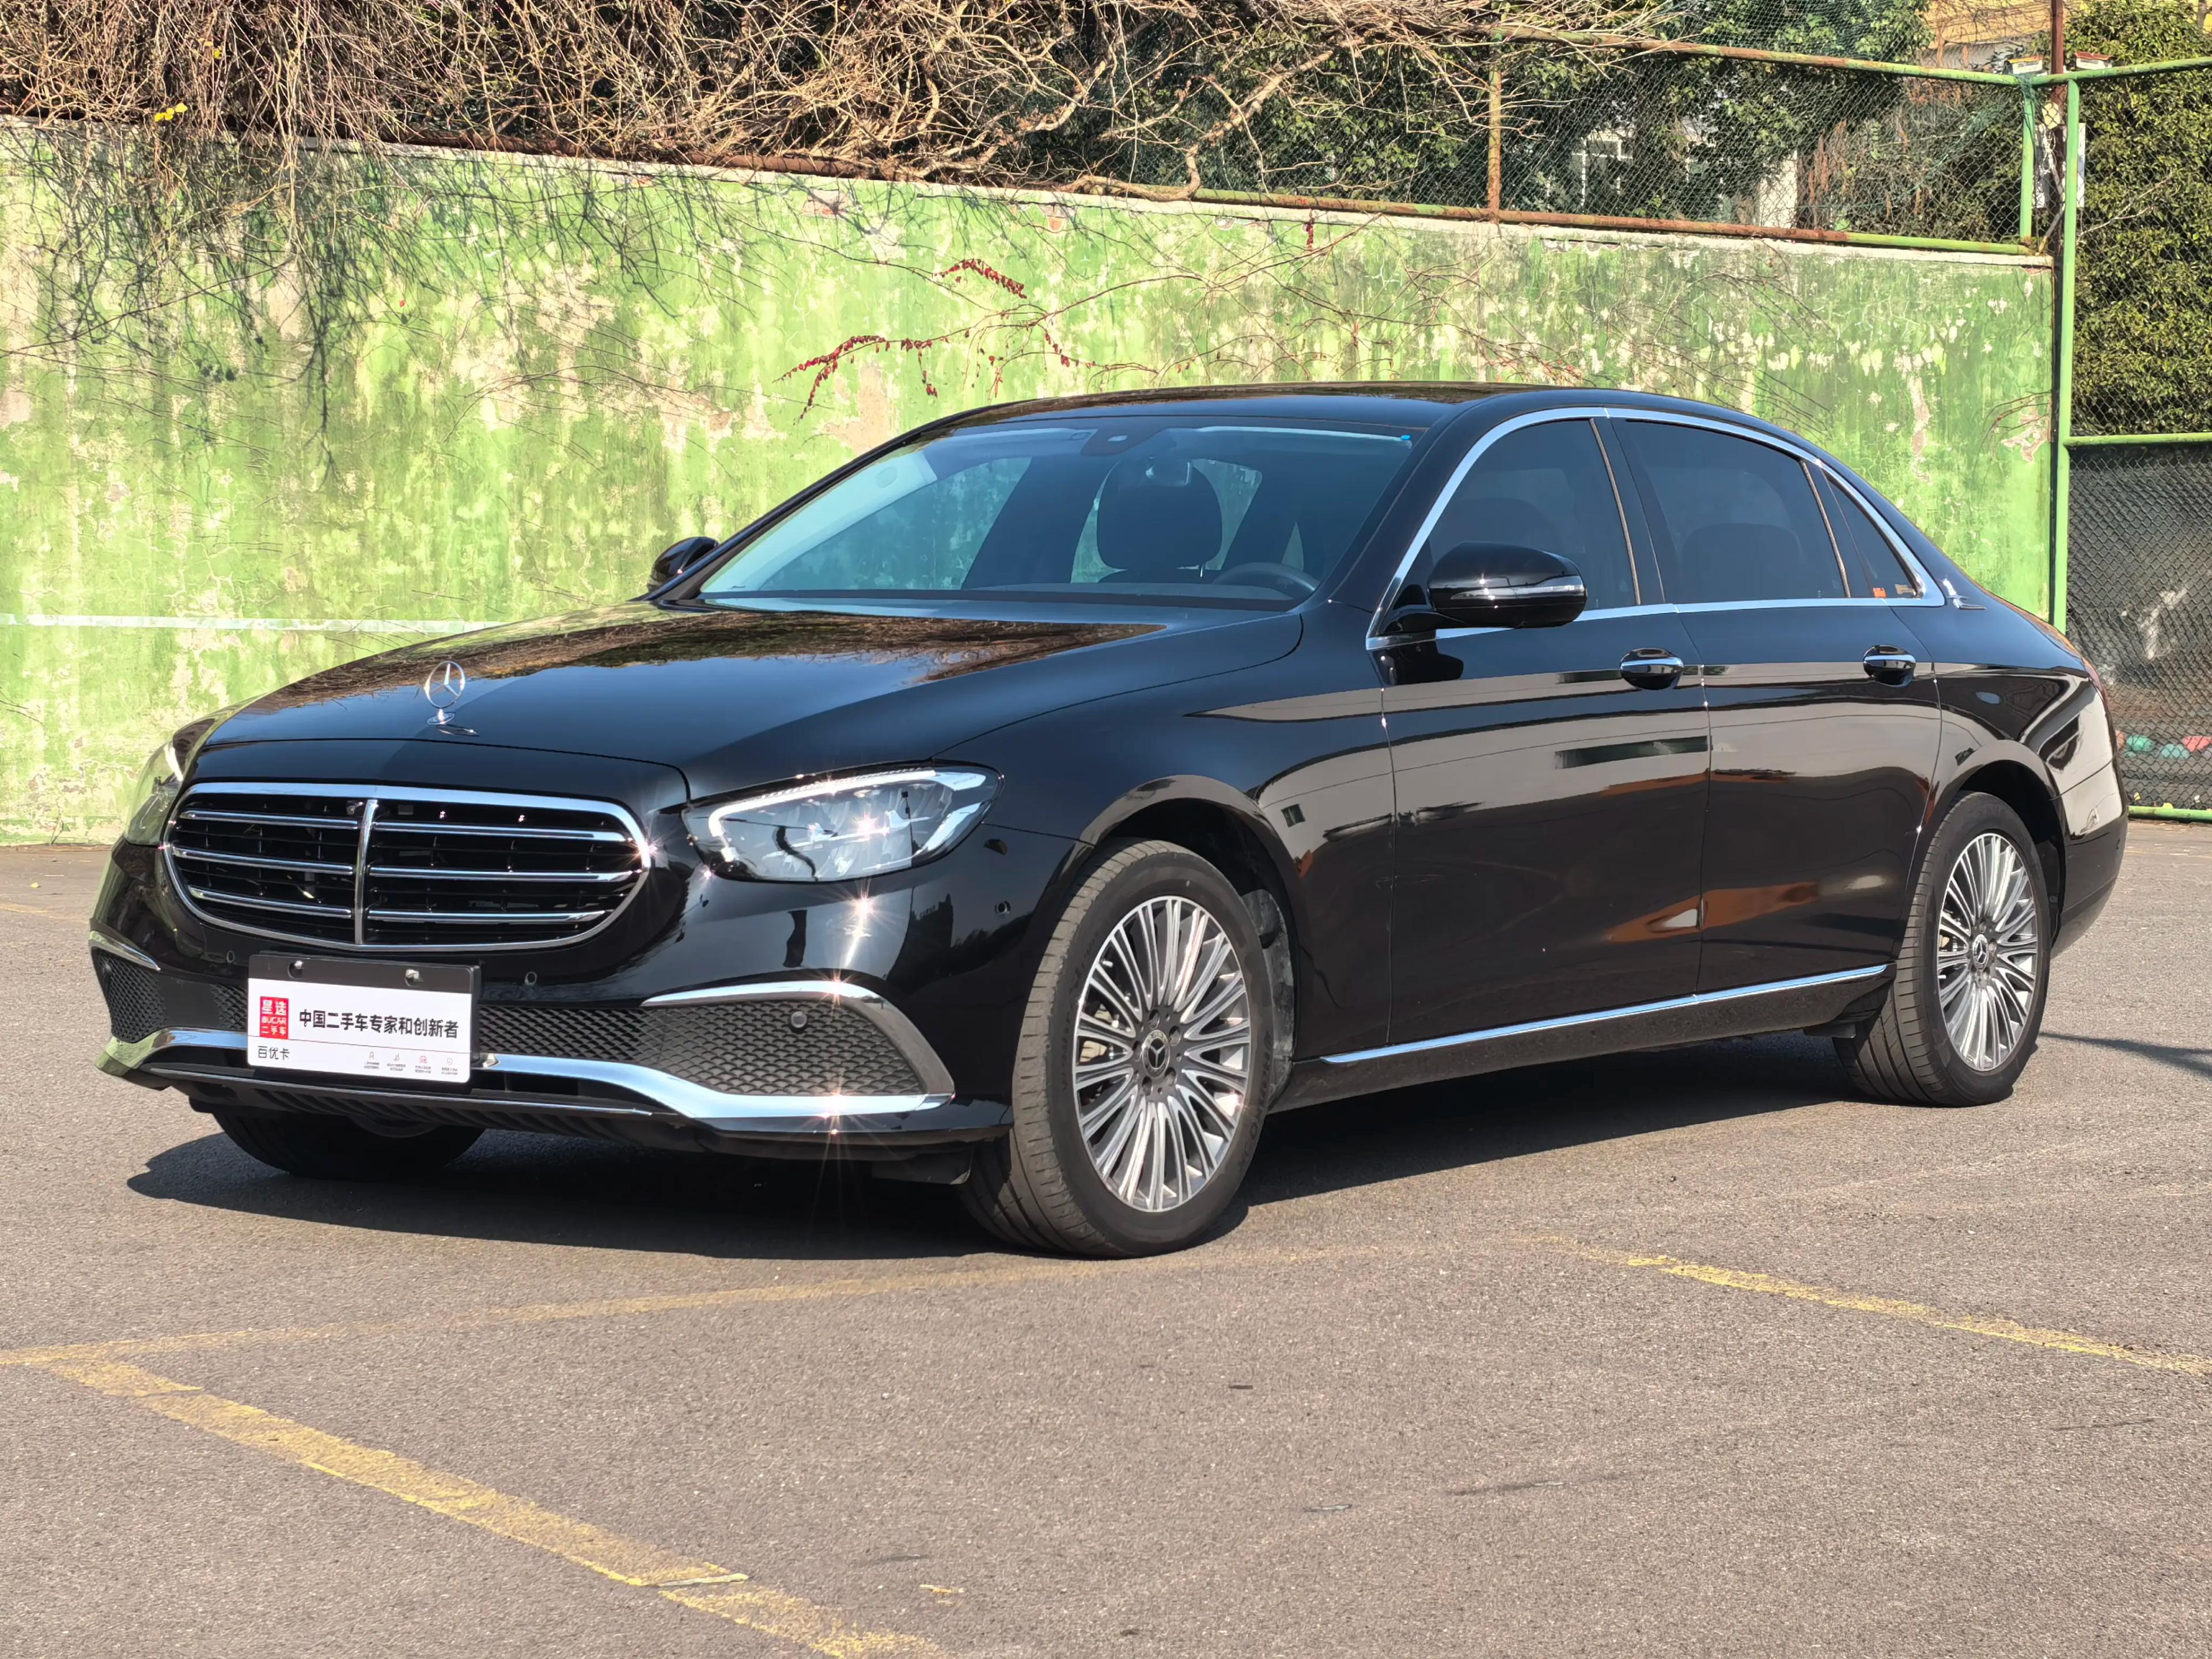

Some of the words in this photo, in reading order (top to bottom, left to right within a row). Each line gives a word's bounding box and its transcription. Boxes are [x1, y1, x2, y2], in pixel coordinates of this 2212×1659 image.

[261, 1025, 287, 1036] 二手车
[299, 1009, 459, 1039] 中国二手车专家和创新者
[257, 1046, 290, 1060] 百优卡
